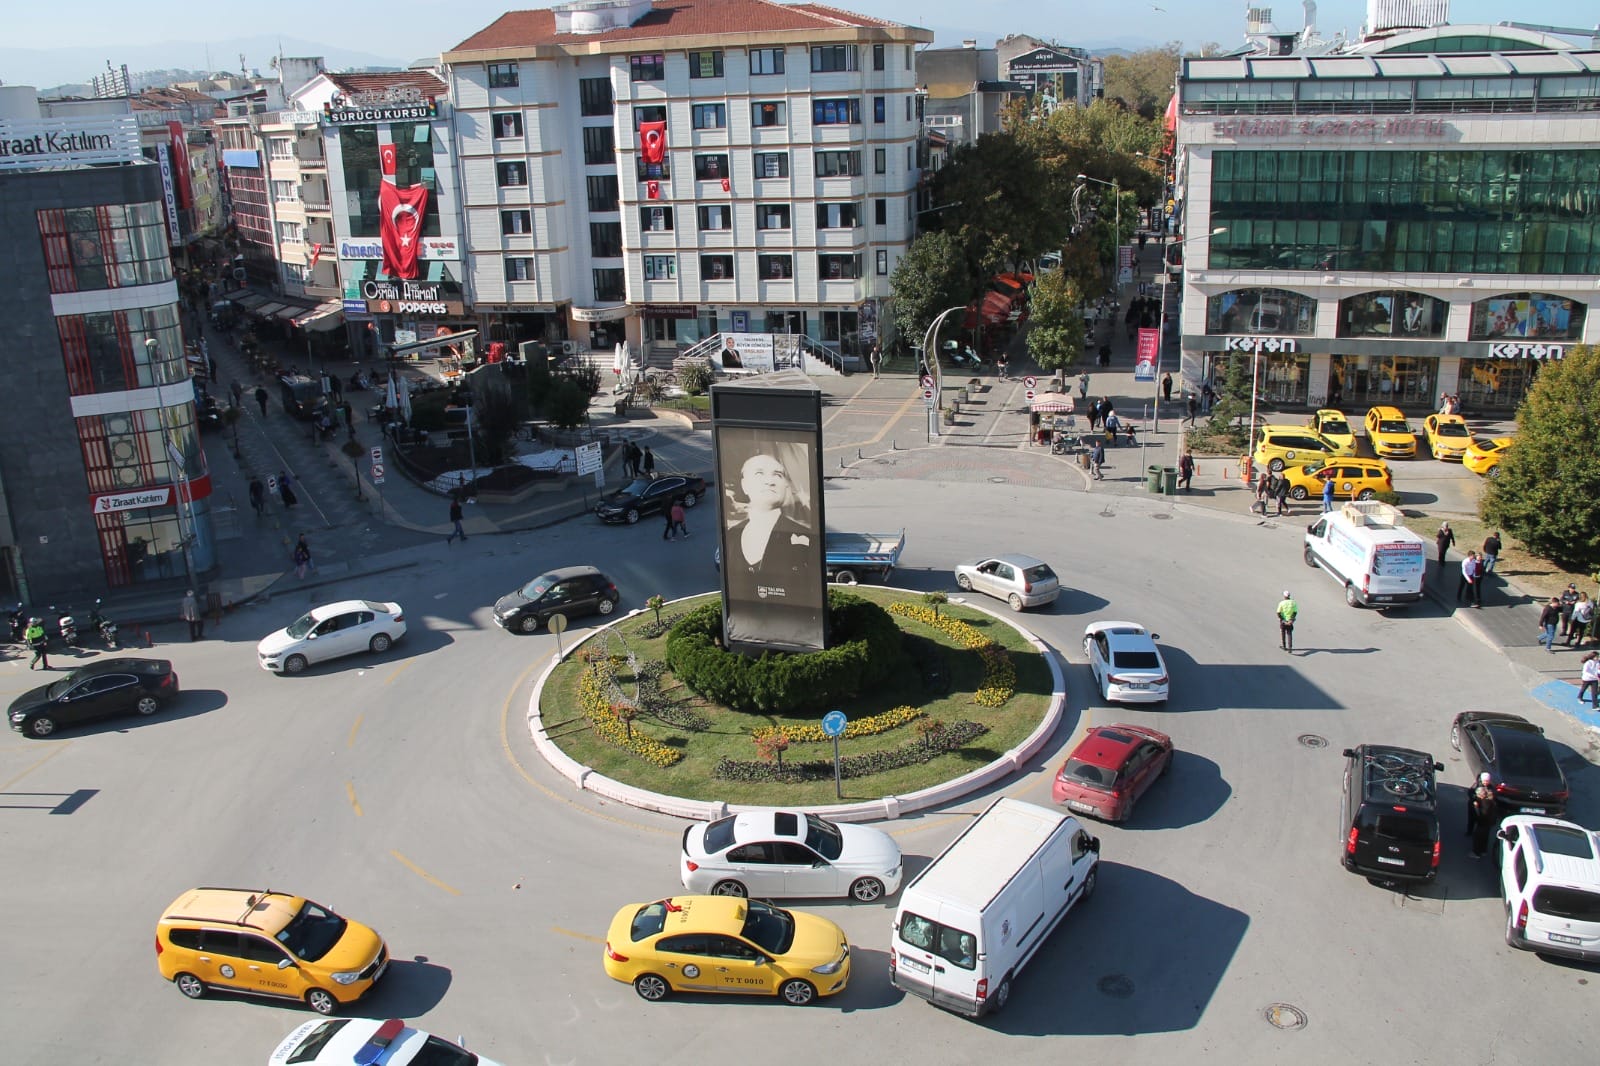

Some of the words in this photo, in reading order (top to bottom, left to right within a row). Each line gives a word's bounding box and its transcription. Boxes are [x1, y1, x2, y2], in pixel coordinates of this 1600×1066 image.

[331, 109, 382, 122] SÜRÜCÜ
[384, 108, 427, 120] KURSU
[45, 130, 111, 153] Katılım
[1225, 337, 1296, 353] KOTON
[1488, 343, 1563, 360] KOTON
[112, 497, 137, 508] Ziraat
